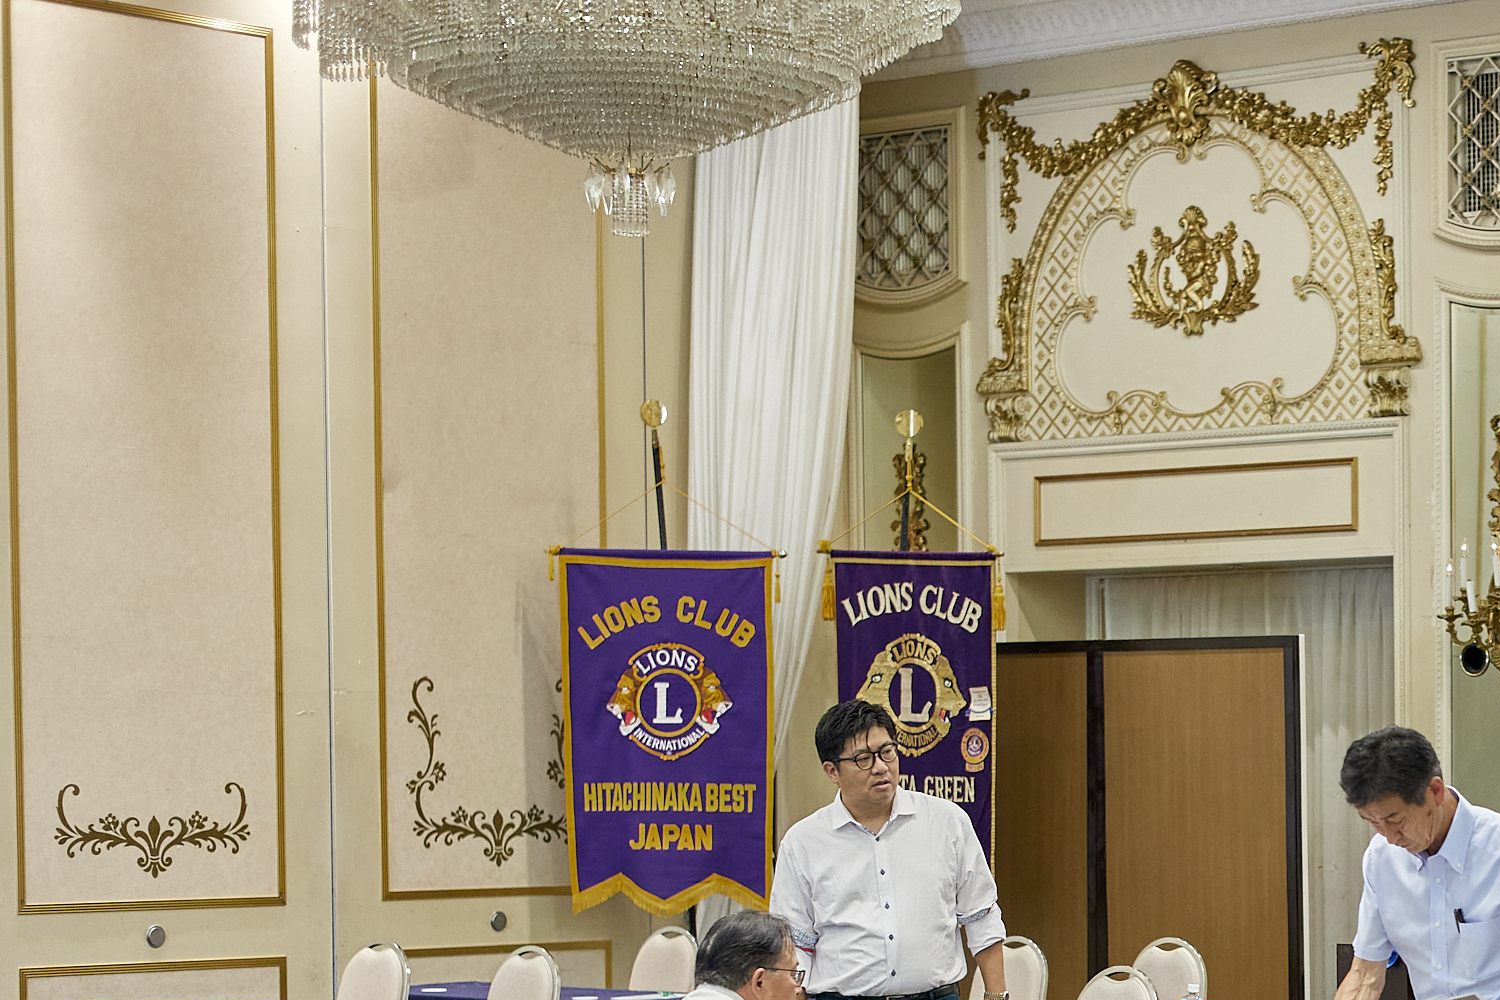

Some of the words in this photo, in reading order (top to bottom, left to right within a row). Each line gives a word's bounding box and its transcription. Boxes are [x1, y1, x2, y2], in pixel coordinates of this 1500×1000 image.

[577, 595, 661, 650] LIONS
[676, 595, 756, 648] CLUB
[841, 581, 914, 627] LIONS
[919, 584, 984, 634] CLUB
[635, 649, 699, 675] LIONS
[891, 640, 937, 665] LIONS
[652, 682, 683, 724] L
[898, 667, 933, 723] L
[633, 727, 706, 751] INTERNATIONAL
[583, 782, 703, 812] HITACHINAKA
[705, 782, 757, 813] BEST
[899, 774, 917, 793] TA
[924, 775, 976, 803] GREEN
[629, 823, 713, 851] JAPAN
